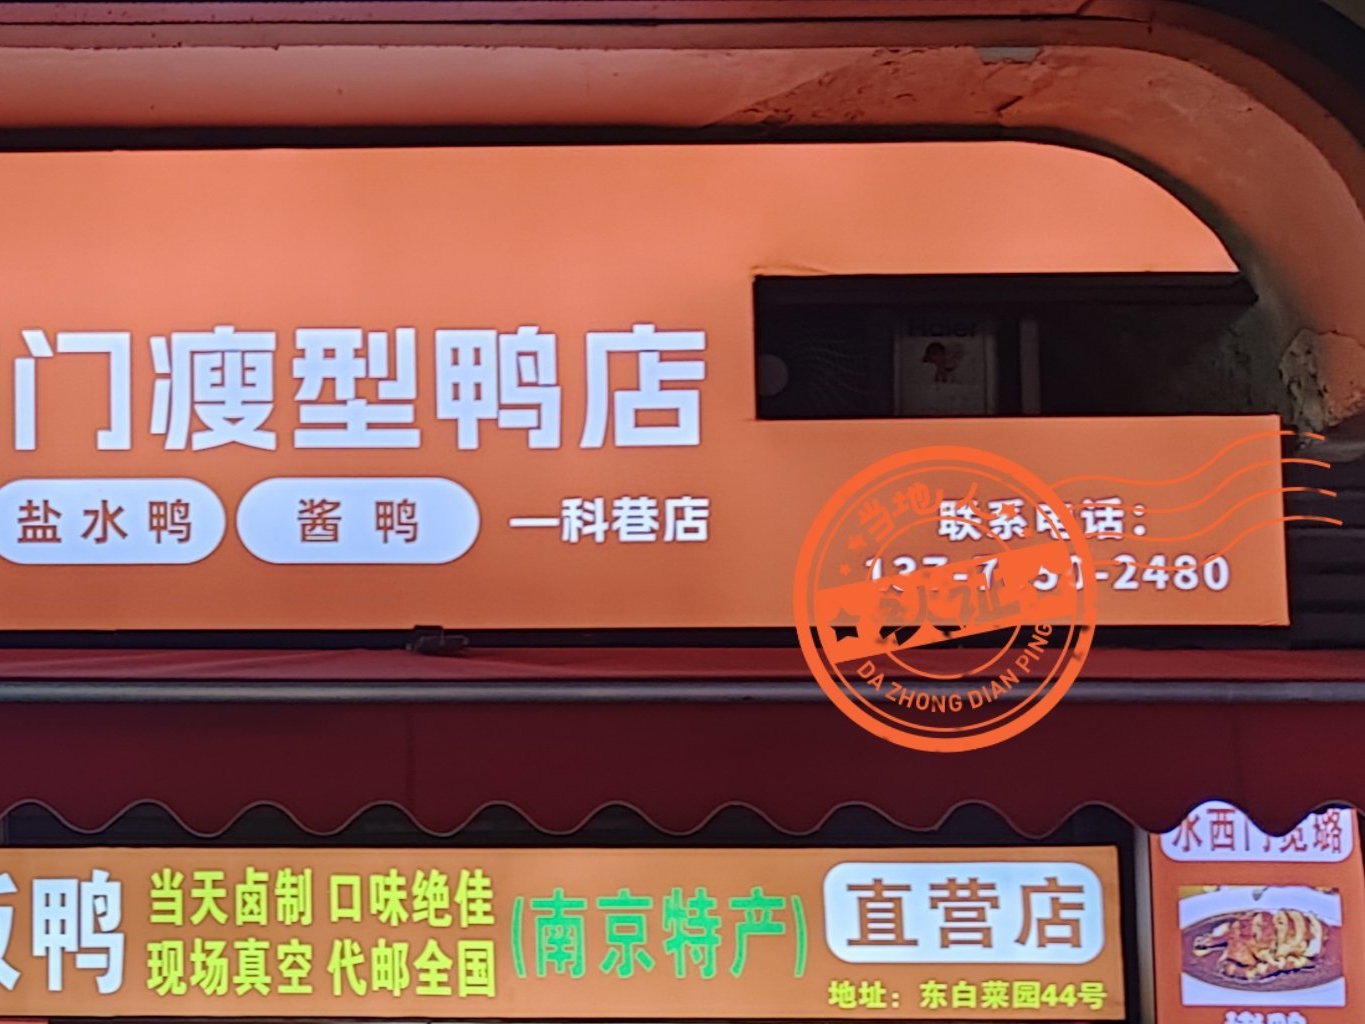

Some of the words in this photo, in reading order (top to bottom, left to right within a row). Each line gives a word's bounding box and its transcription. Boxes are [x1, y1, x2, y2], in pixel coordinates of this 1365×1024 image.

[16, 499, 193, 545] 盐水鸭
[296, 499, 418, 545] 酱鸭
[149, 867, 313, 927] 当天卤制
[330, 868, 496, 928] 口味绝佳
[846, 876, 1085, 949] 直营店
[146, 938, 313, 997] 现场真空
[327, 938, 497, 998] 代邮全国
